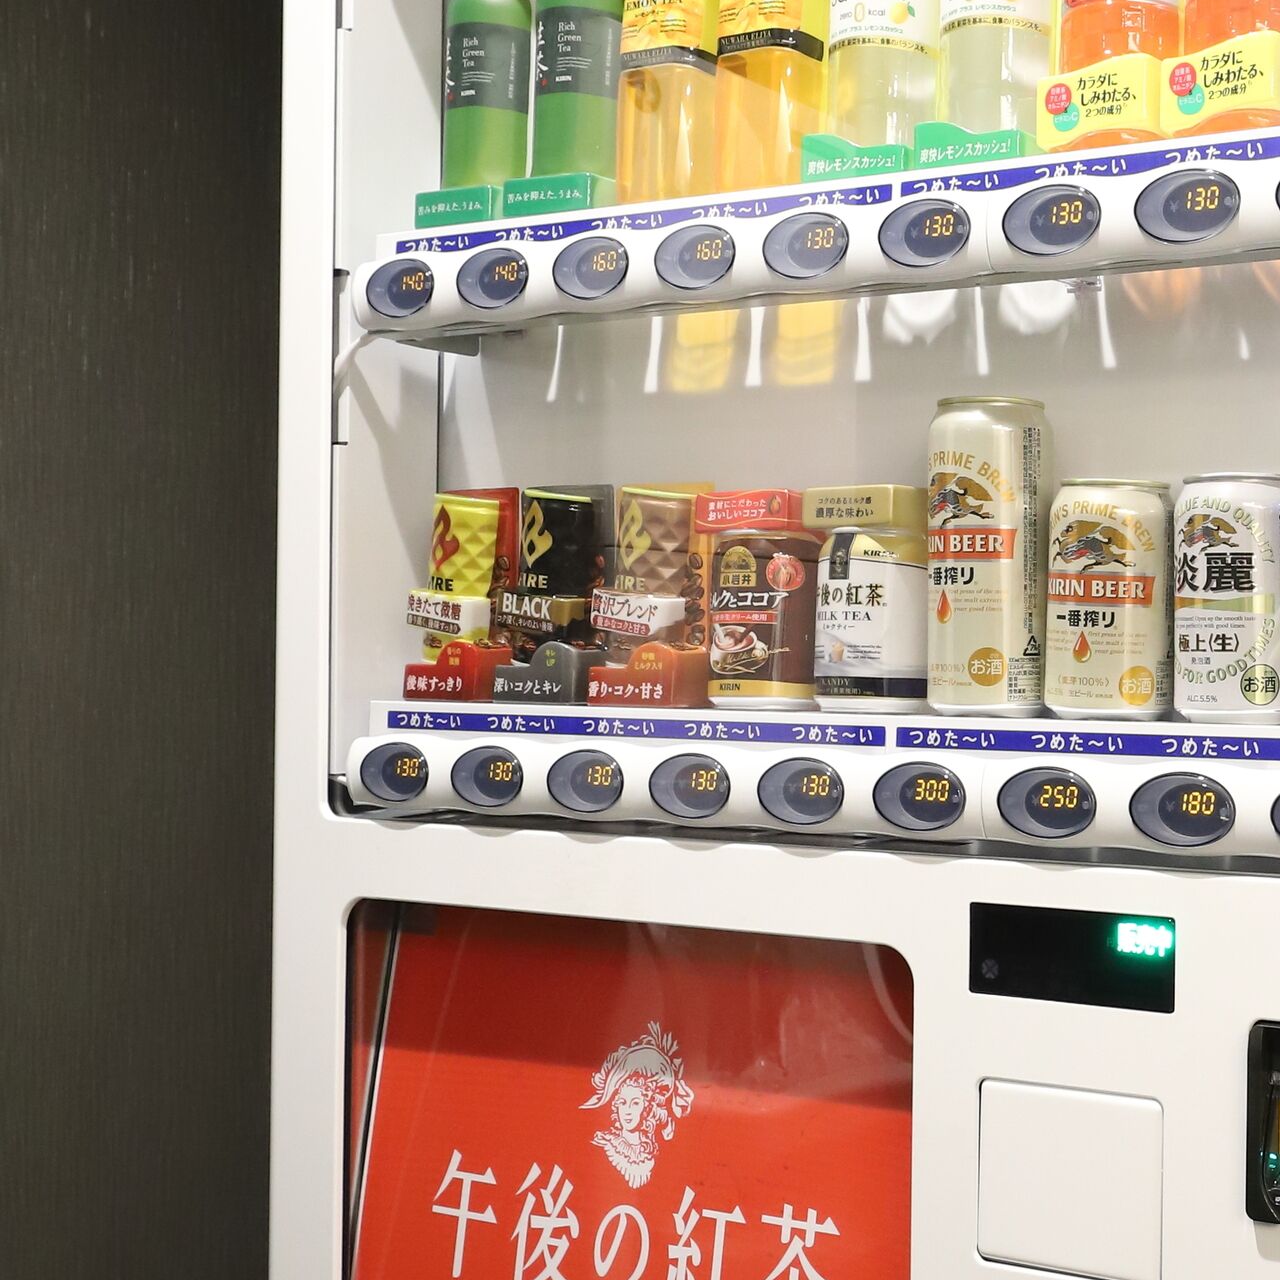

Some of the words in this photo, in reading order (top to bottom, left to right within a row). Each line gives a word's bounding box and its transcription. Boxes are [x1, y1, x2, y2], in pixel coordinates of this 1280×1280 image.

[1200, 50, 1243, 71] カラダに
[1077, 73, 1118, 91] カラダに
[1203, 65, 1264, 89] しみわたる、
[1081, 89, 1136, 107] しみわたる、
[919, 137, 1011, 165] 爽快レモンスカッシュ!
[807, 154, 896, 176] 爽快レモンスカッシュ!
[1185, 186, 1219, 210] 130
[1050, 201, 1083, 225] 130
[924, 215, 955, 237] 130
[807, 227, 835, 248] 130
[695, 239, 723, 260] 160
[592, 251, 617, 271] 160
[402, 272, 424, 291] 140
[494, 262, 518, 281] 140
[933, 451, 976, 471] PRIME
[708, 498, 767, 510] 素材にこだわった
[816, 506, 874, 519] 濃厚な味わい
[1072, 500, 1121, 521] PRIME
[707, 508, 766, 521] おいしいココア
[949, 534, 1006, 553] BEER
[721, 573, 751, 586] 小岩井
[1174, 552, 1257, 594] 淡麗
[1091, 581, 1145, 599] BEER
[502, 593, 551, 620] BLACK
[842, 611, 872, 621] TEA
[1056, 610, 1116, 629] 一番搾り
[1179, 633, 1240, 654] 極上〈生〉
[970, 658, 1003, 676] お酒
[406, 675, 463, 693] 後味すっきり
[493, 677, 562, 695] 深いコクとキレ
[588, 682, 664, 700] 香り・コク・甘さ
[719, 683, 741, 691] KIRIN
[1122, 677, 1152, 694] お酒
[1243, 676, 1277, 693] お酒
[396, 757, 420, 778] 130
[488, 761, 513, 782] 130
[587, 765, 612, 786] 130
[691, 769, 718, 791] 130
[801, 774, 830, 796] 130
[914, 779, 949, 803] 300
[1039, 784, 1079, 810] 250
[1180, 790, 1216, 817] 180
